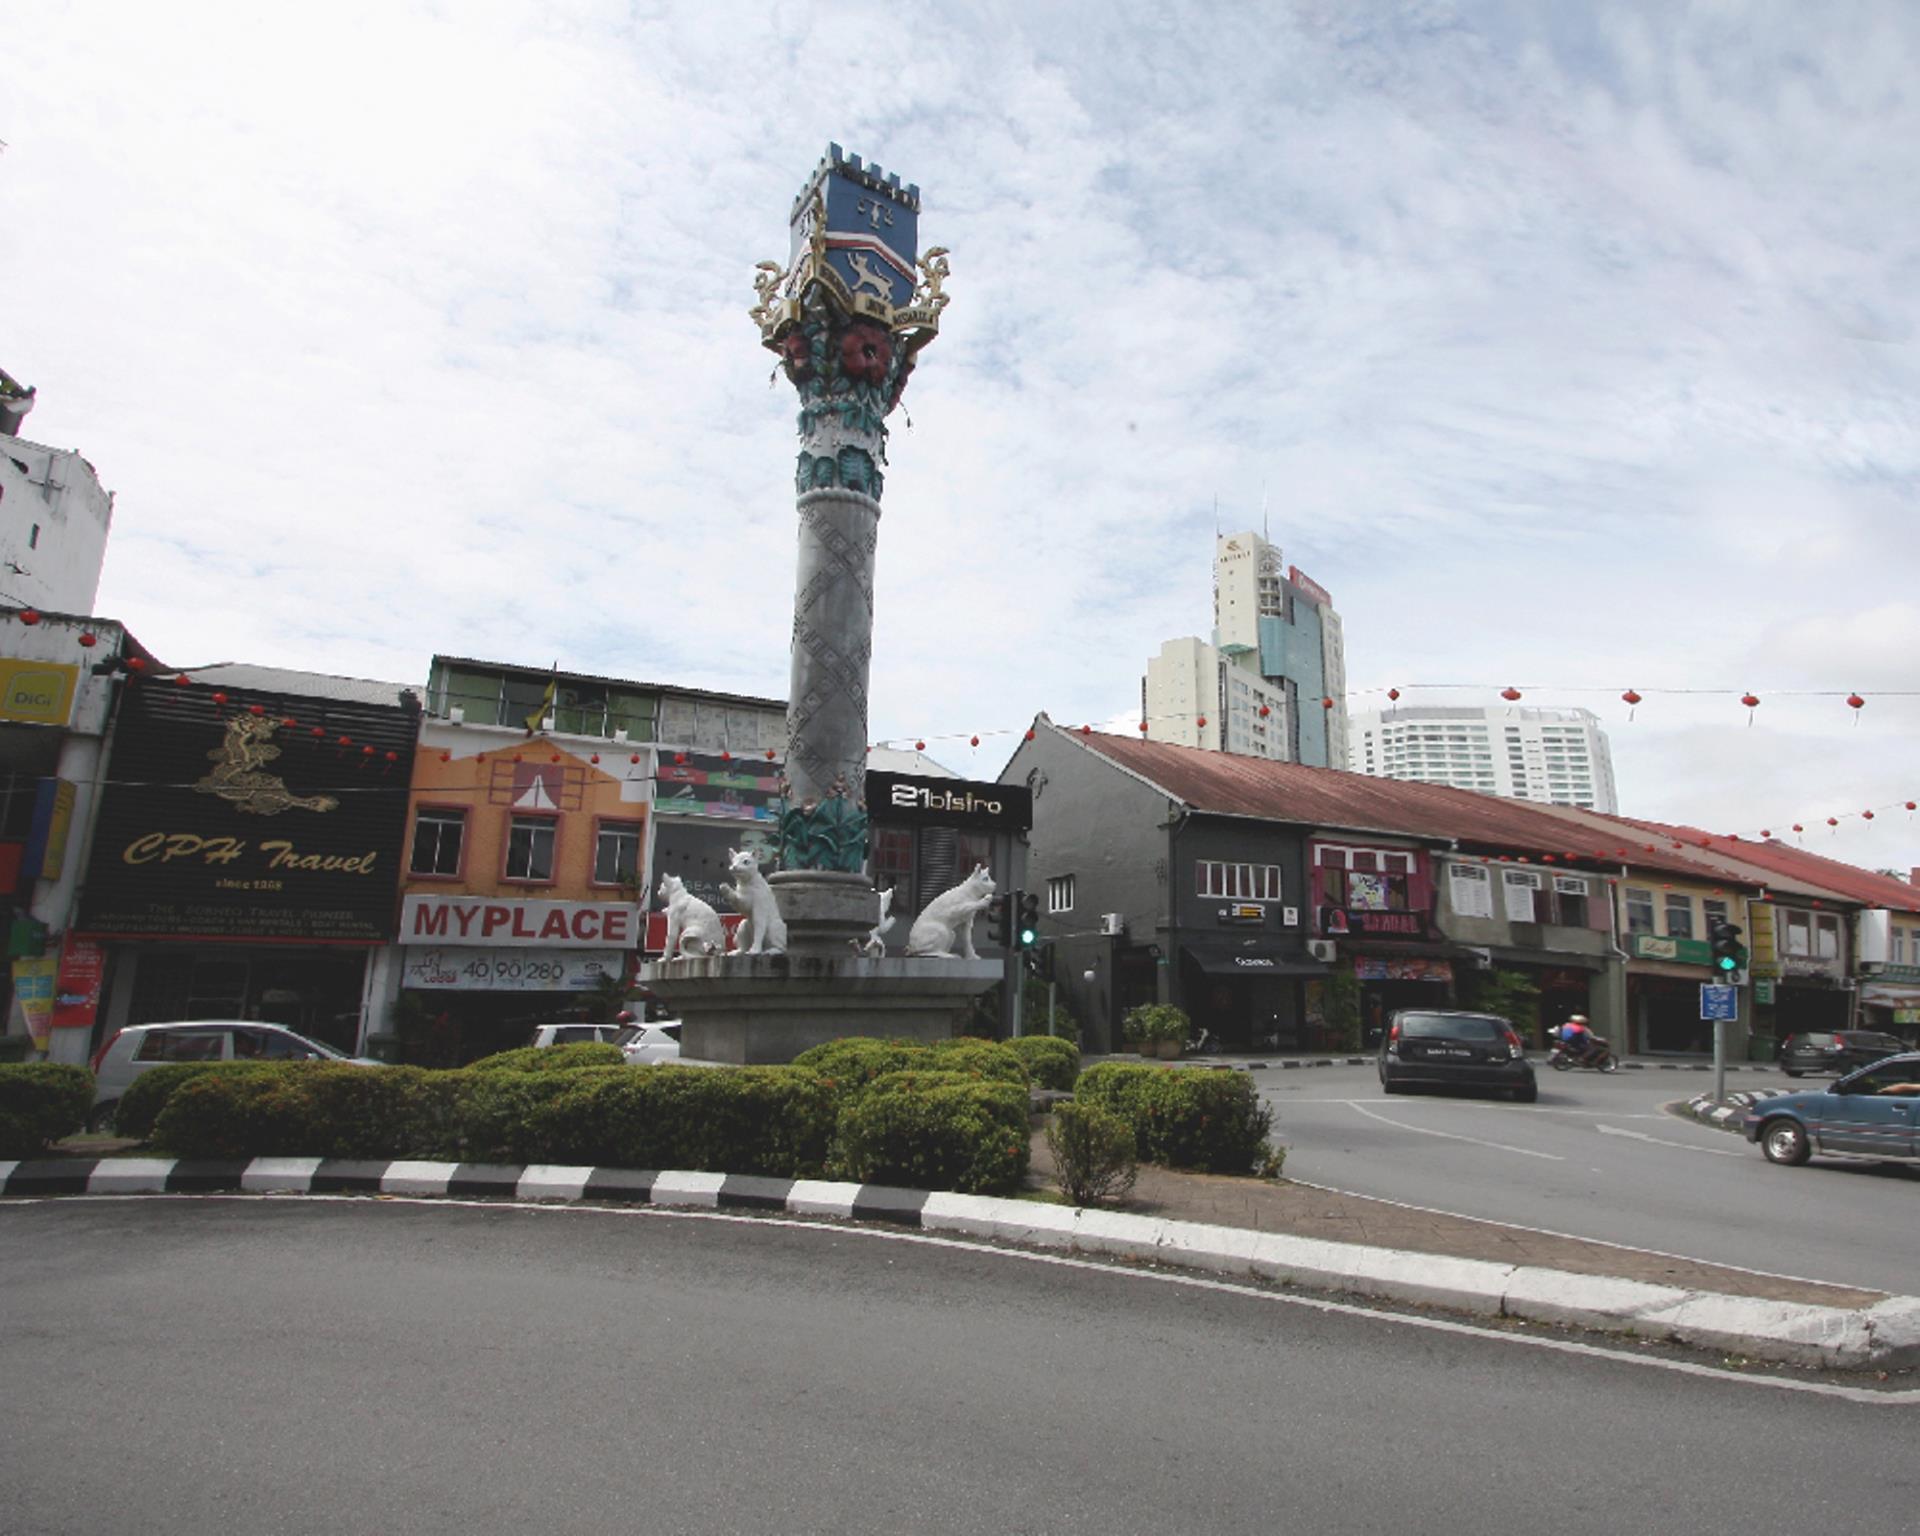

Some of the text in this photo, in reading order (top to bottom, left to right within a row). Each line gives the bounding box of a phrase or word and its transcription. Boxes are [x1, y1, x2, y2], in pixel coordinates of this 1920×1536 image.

[123, 832, 377, 874] CPH Travel
[413, 903, 628, 941] MYPLACE
